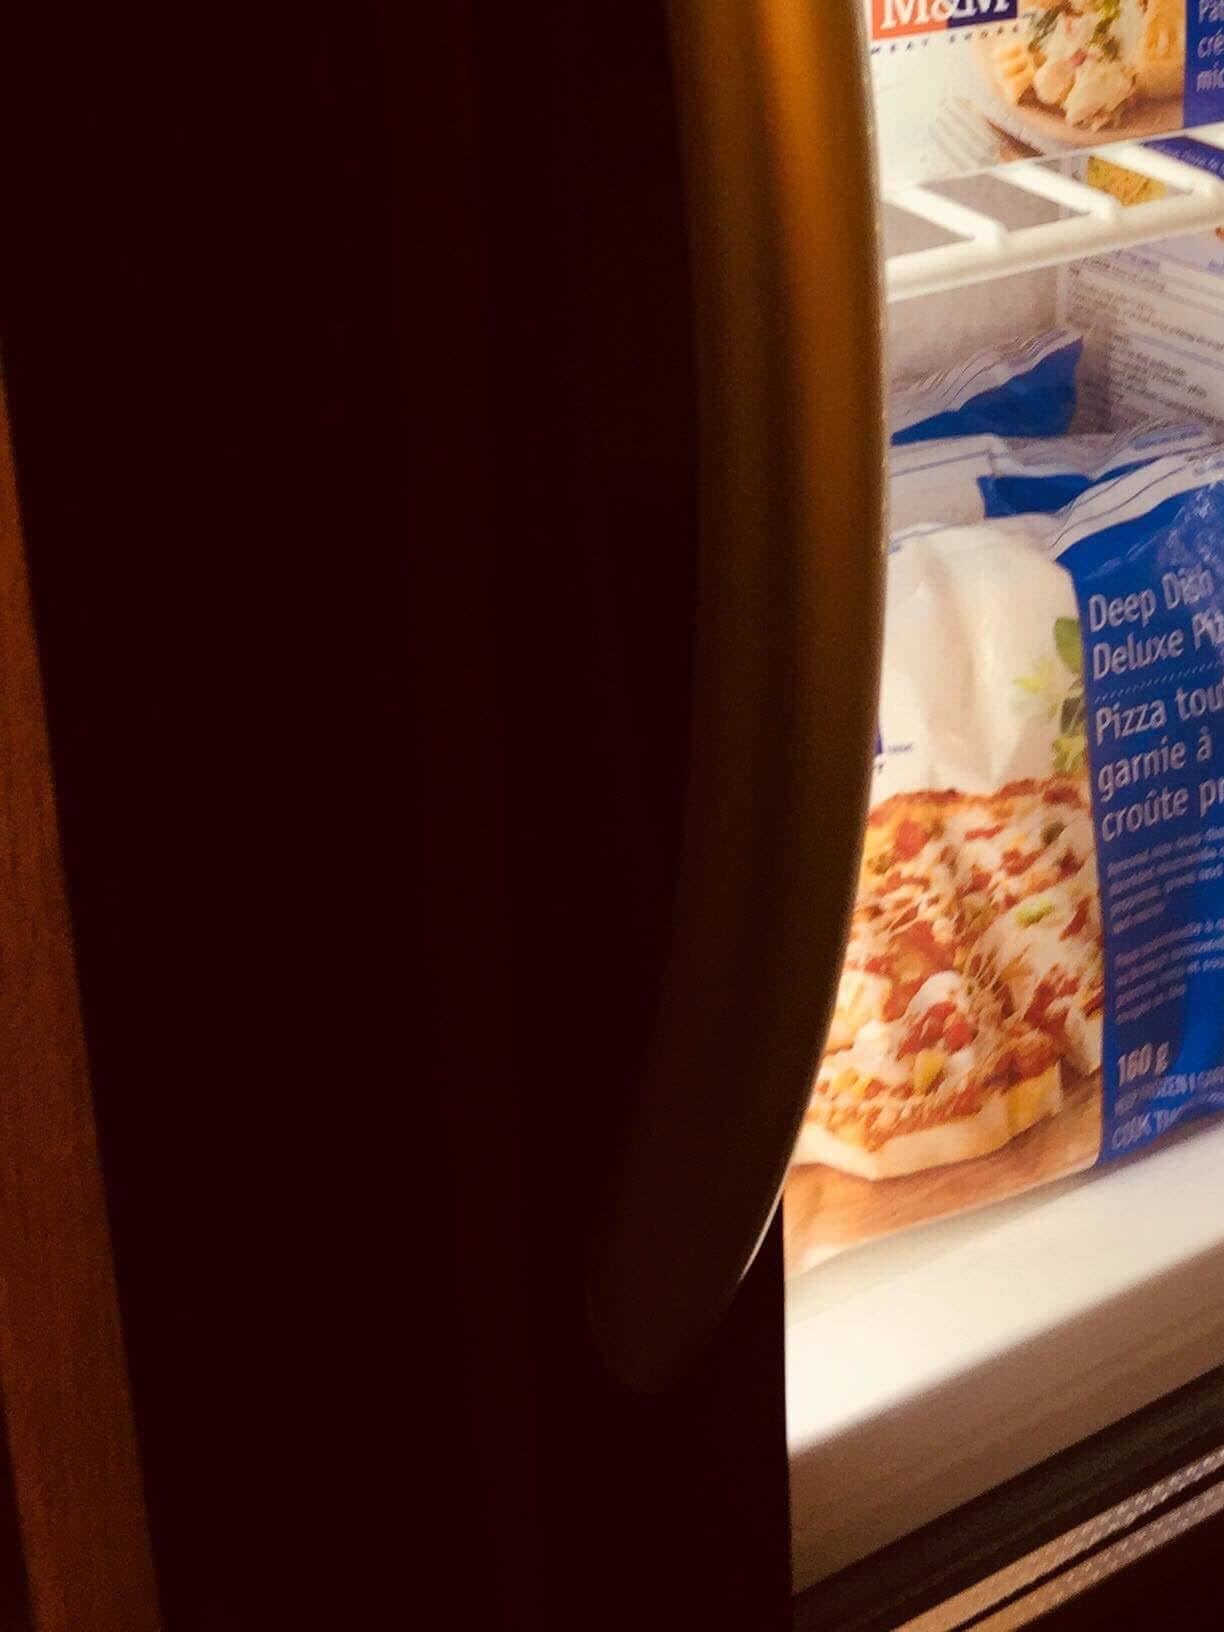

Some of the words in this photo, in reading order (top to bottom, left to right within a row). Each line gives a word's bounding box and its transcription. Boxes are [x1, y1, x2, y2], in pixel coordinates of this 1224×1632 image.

[1088, 588, 1157, 633] Deep
[1092, 628, 1185, 681] Deluxe
[1095, 699, 1168, 747] Pizza
[1097, 735, 1187, 803] garnie
[1195, 724, 1213, 762] à
[1101, 785, 1190, 843] croûte
